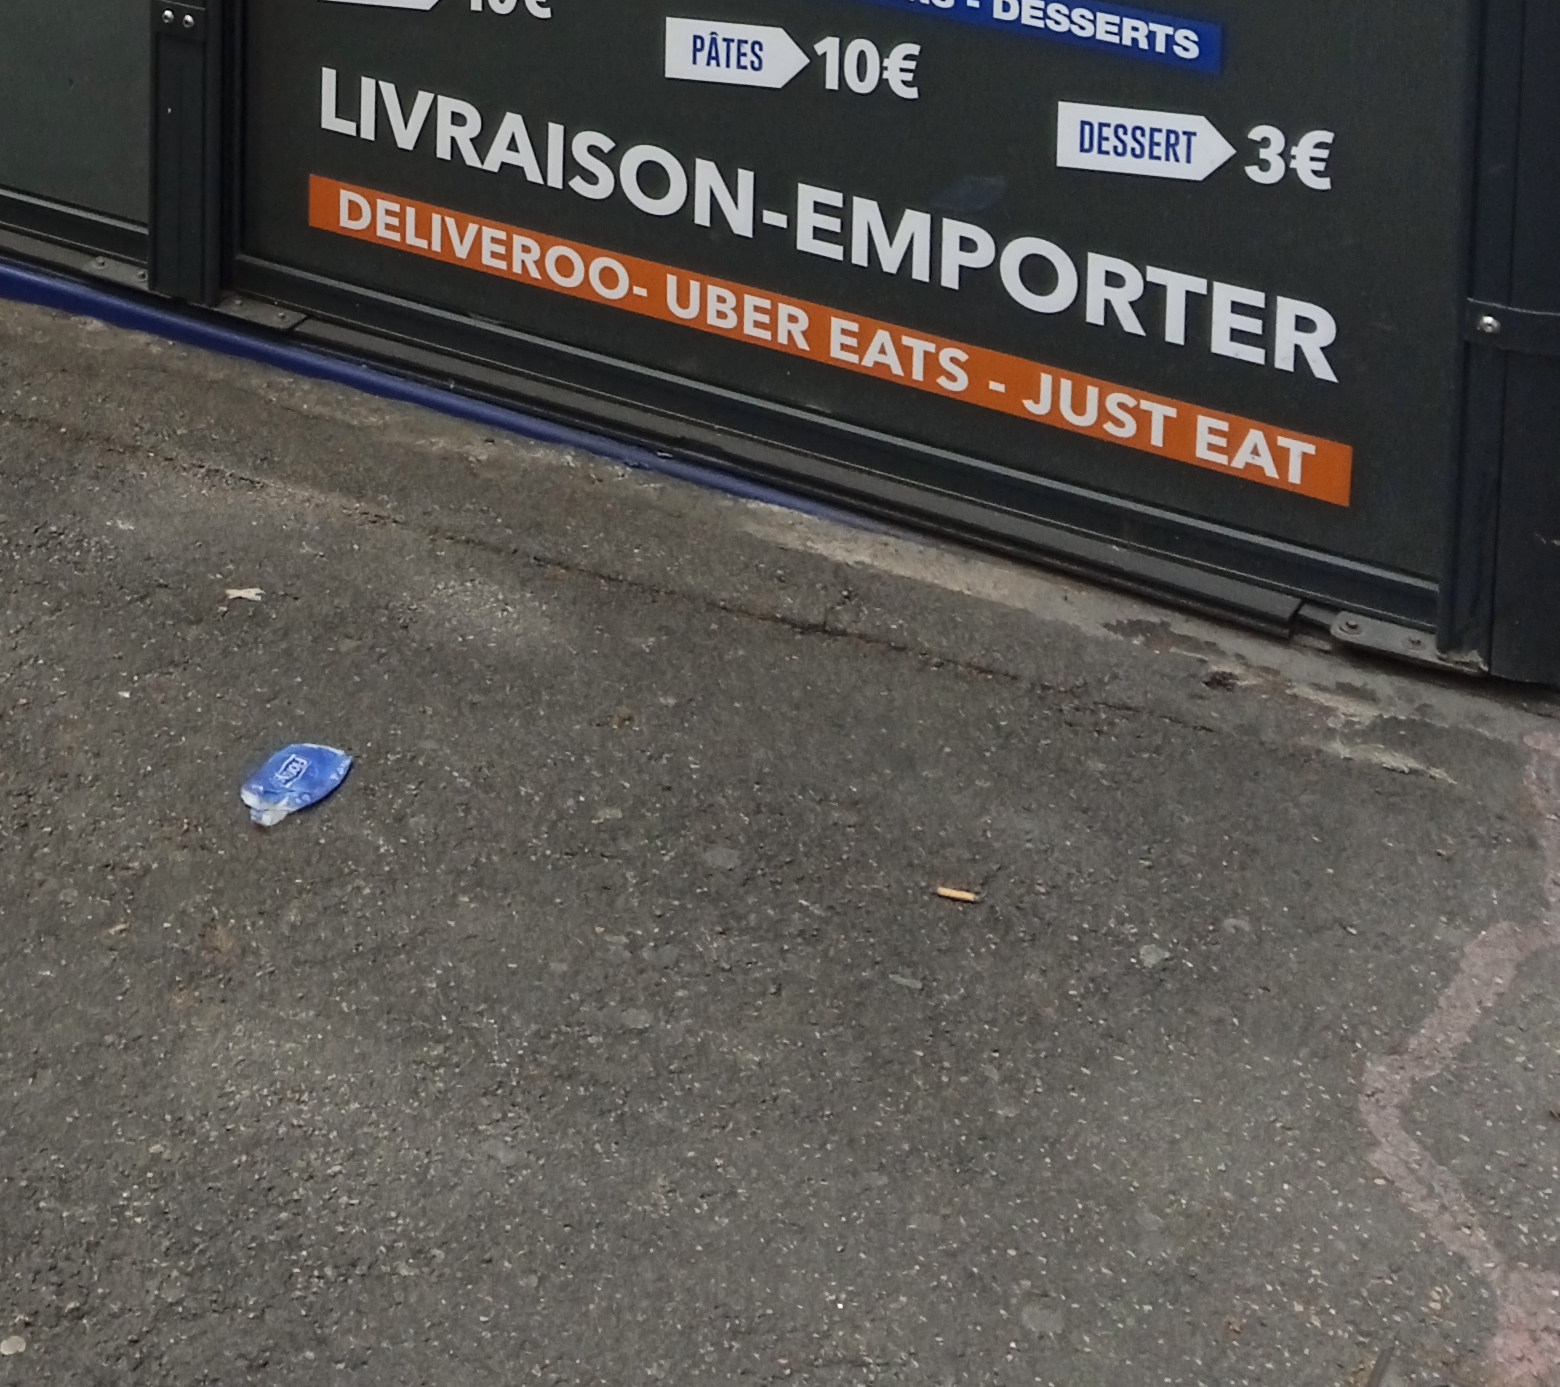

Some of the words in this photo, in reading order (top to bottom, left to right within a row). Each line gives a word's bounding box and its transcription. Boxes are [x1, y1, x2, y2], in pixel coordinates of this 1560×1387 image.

[691, 30, 764, 74] PÂTES
[812, 36, 921, 100] 10€
[1078, 119, 1198, 166] DESSERT
[1243, 124, 1336, 193] 3€
[319, 66, 1340, 384] LIVRAISON-EMPORTER
[665, 277, 811, 351] UBER
[830, 316, 970, 395] EATS
[1022, 370, 1179, 449] JUST
[1194, 417, 1318, 487] EAT
